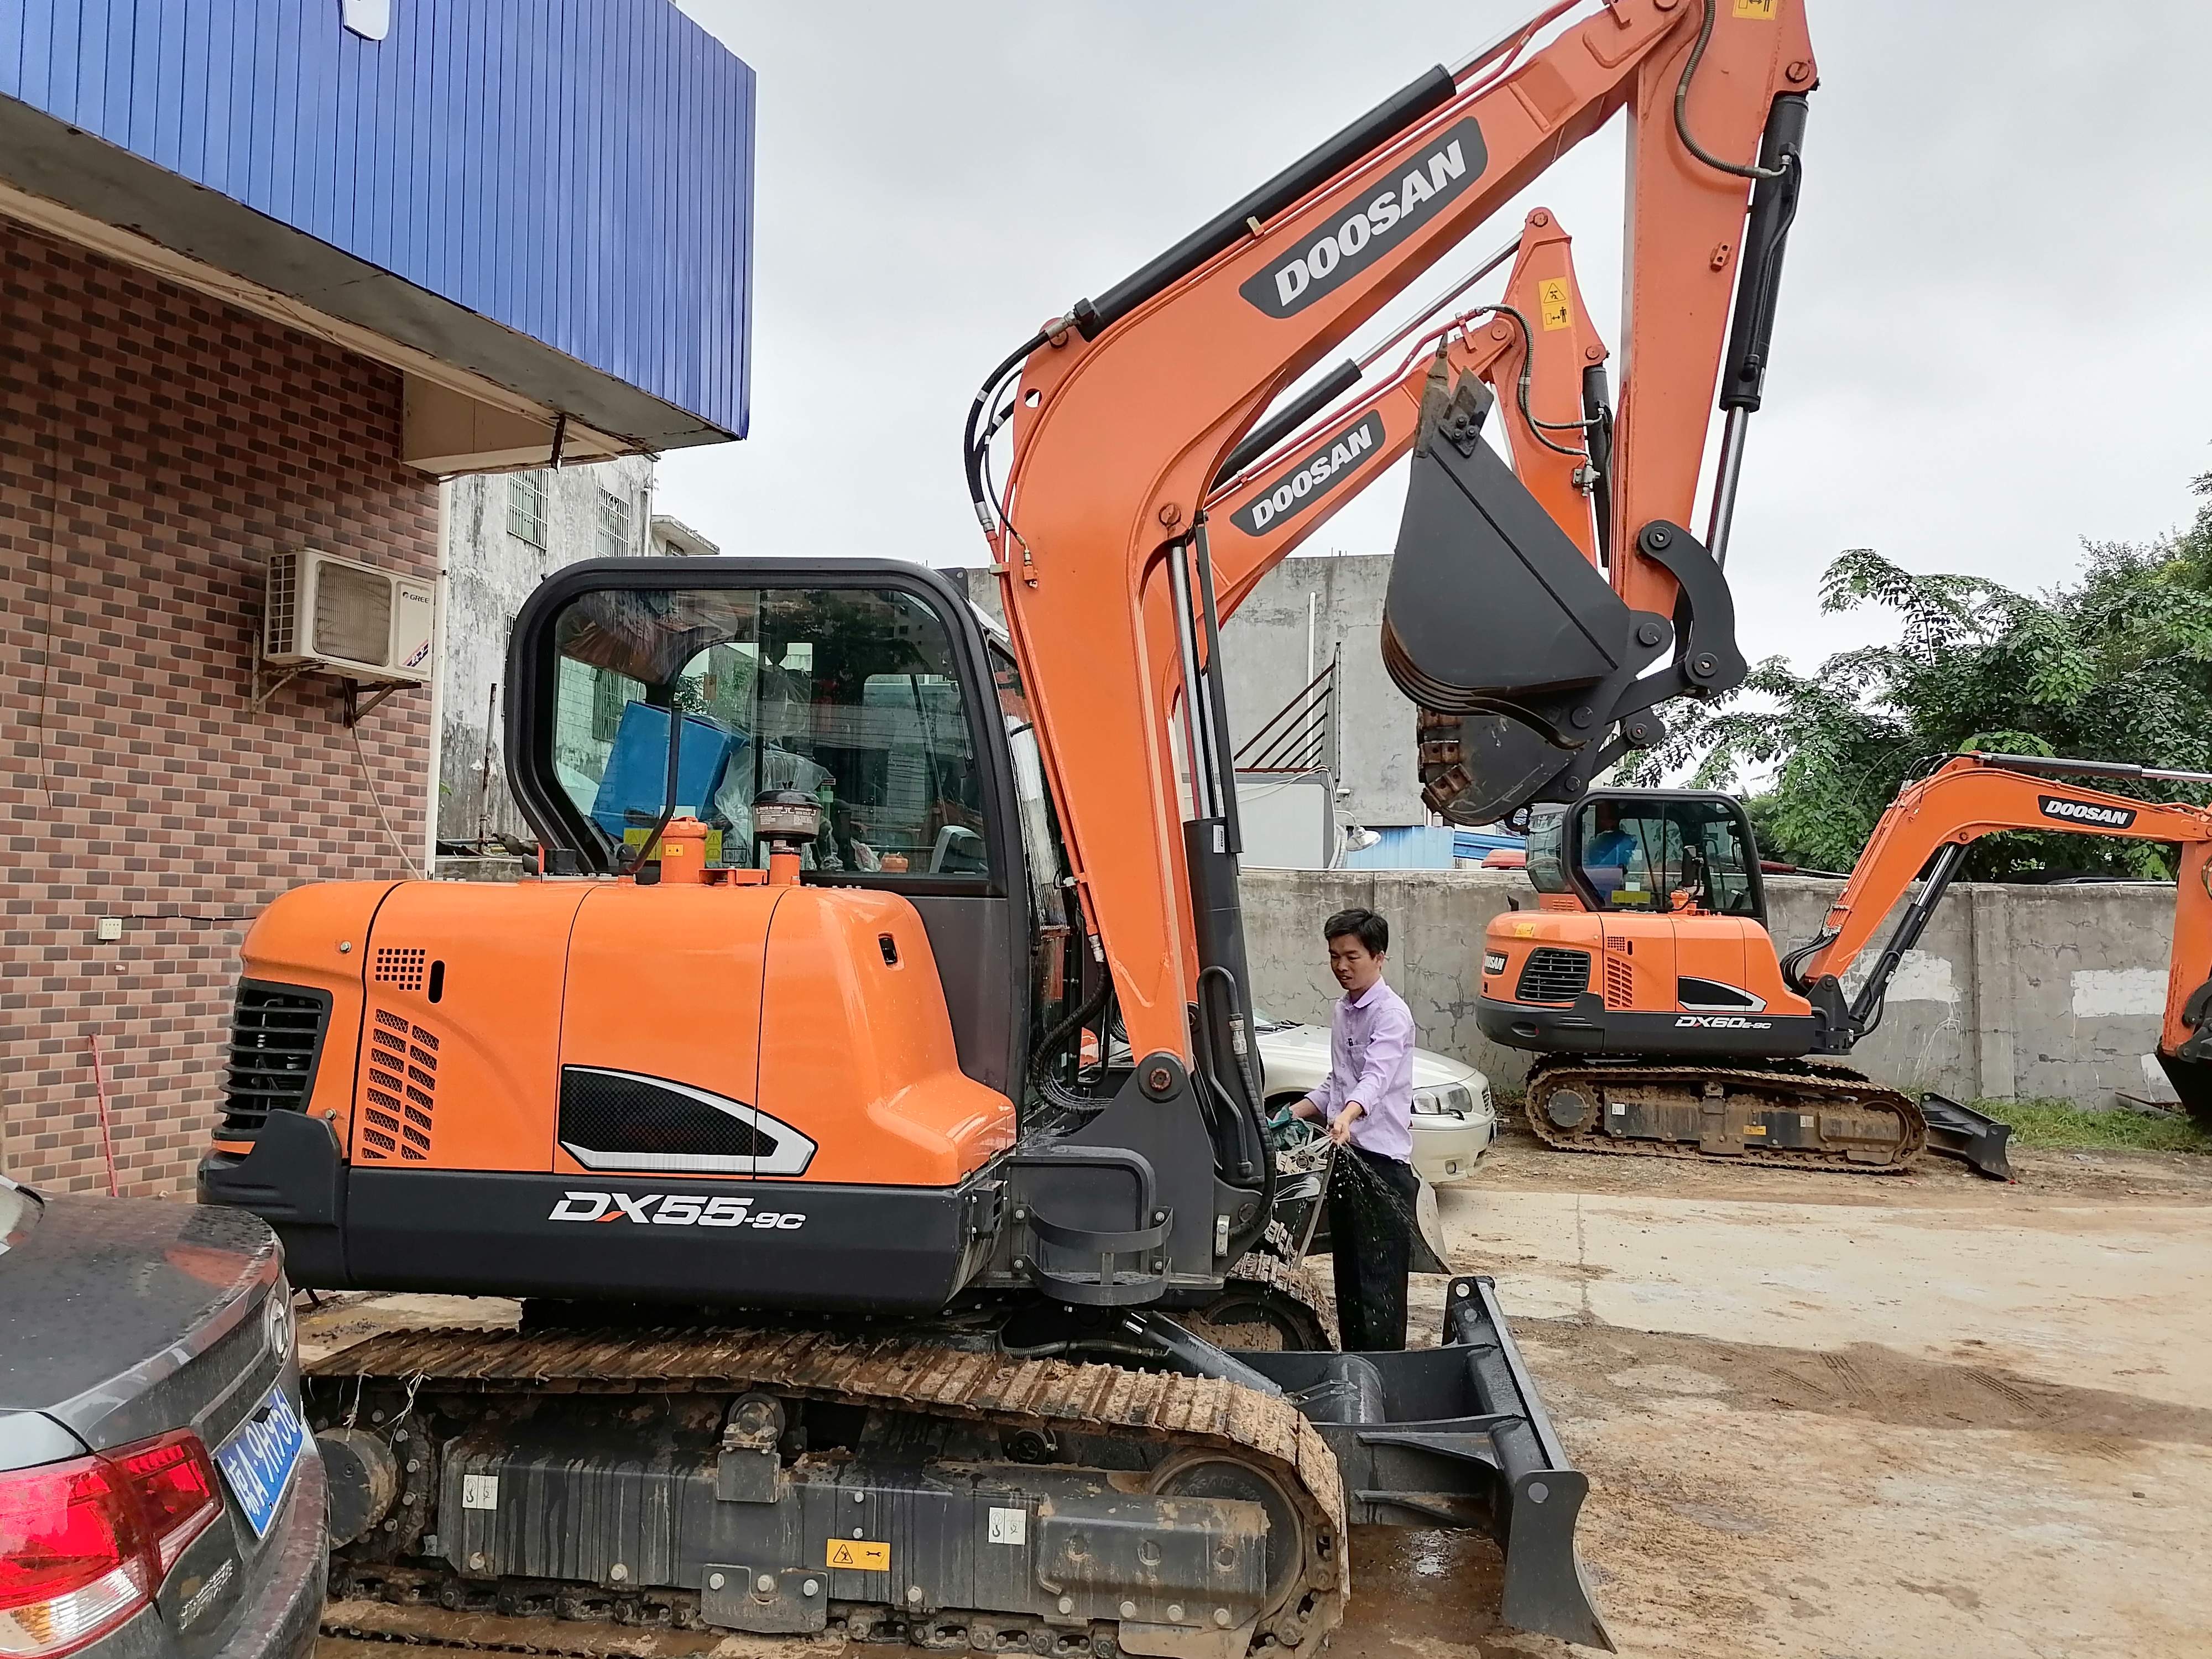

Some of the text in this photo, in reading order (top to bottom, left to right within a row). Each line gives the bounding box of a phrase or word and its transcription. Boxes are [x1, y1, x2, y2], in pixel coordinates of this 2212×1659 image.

[1274, 139, 1467, 307] DOOSAN
[1251, 424, 1373, 530] DOOSAN
[410, 594, 430, 604] GREE
[2045, 800, 2129, 825] DOOSAN
[548, 1191, 806, 1229] DX55-9C
